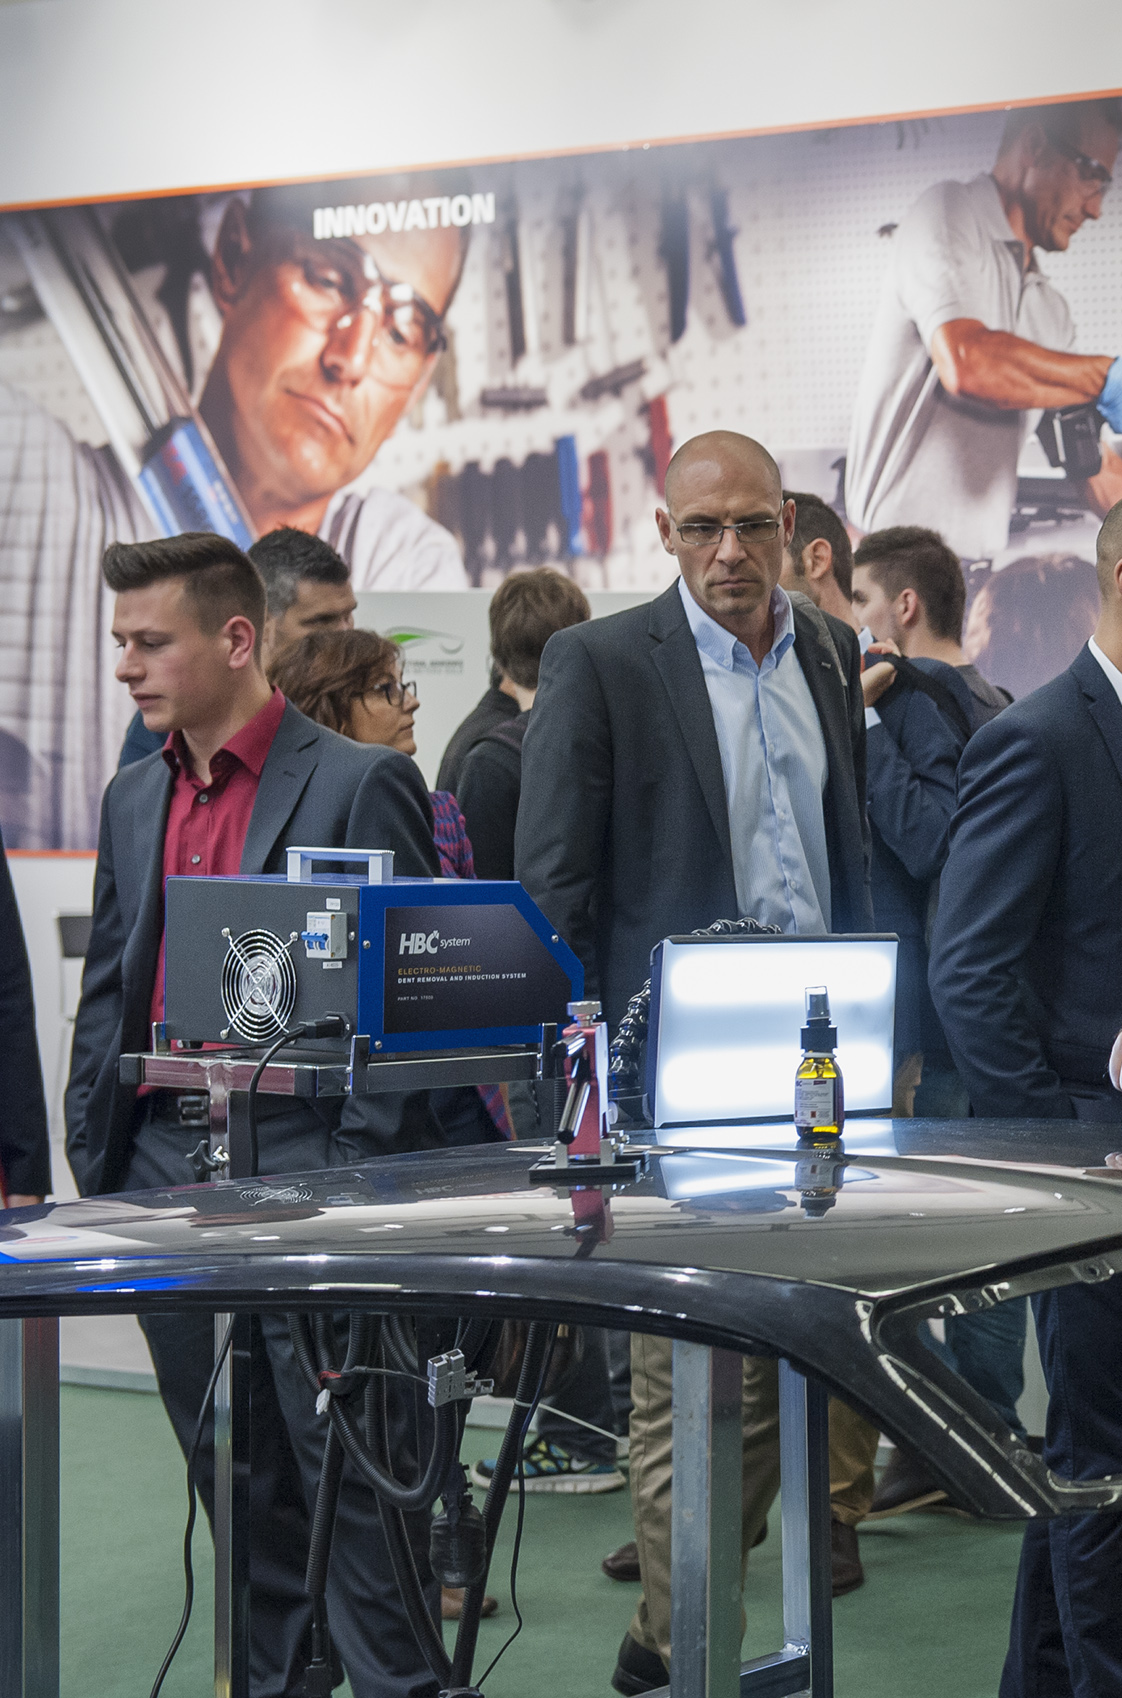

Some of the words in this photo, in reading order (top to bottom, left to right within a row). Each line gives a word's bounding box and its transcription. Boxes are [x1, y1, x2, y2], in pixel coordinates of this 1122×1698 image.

[313, 192, 495, 240] INNOVATION
[398, 930, 440, 955] HBC
[440, 937, 471, 949] system
[397, 964, 482, 976] ELECTRO-MAGNETIC
[397, 976, 416, 984] DENT
[416, 975, 448, 983] REMOVAL
[464, 973, 500, 981] INDUCTION
